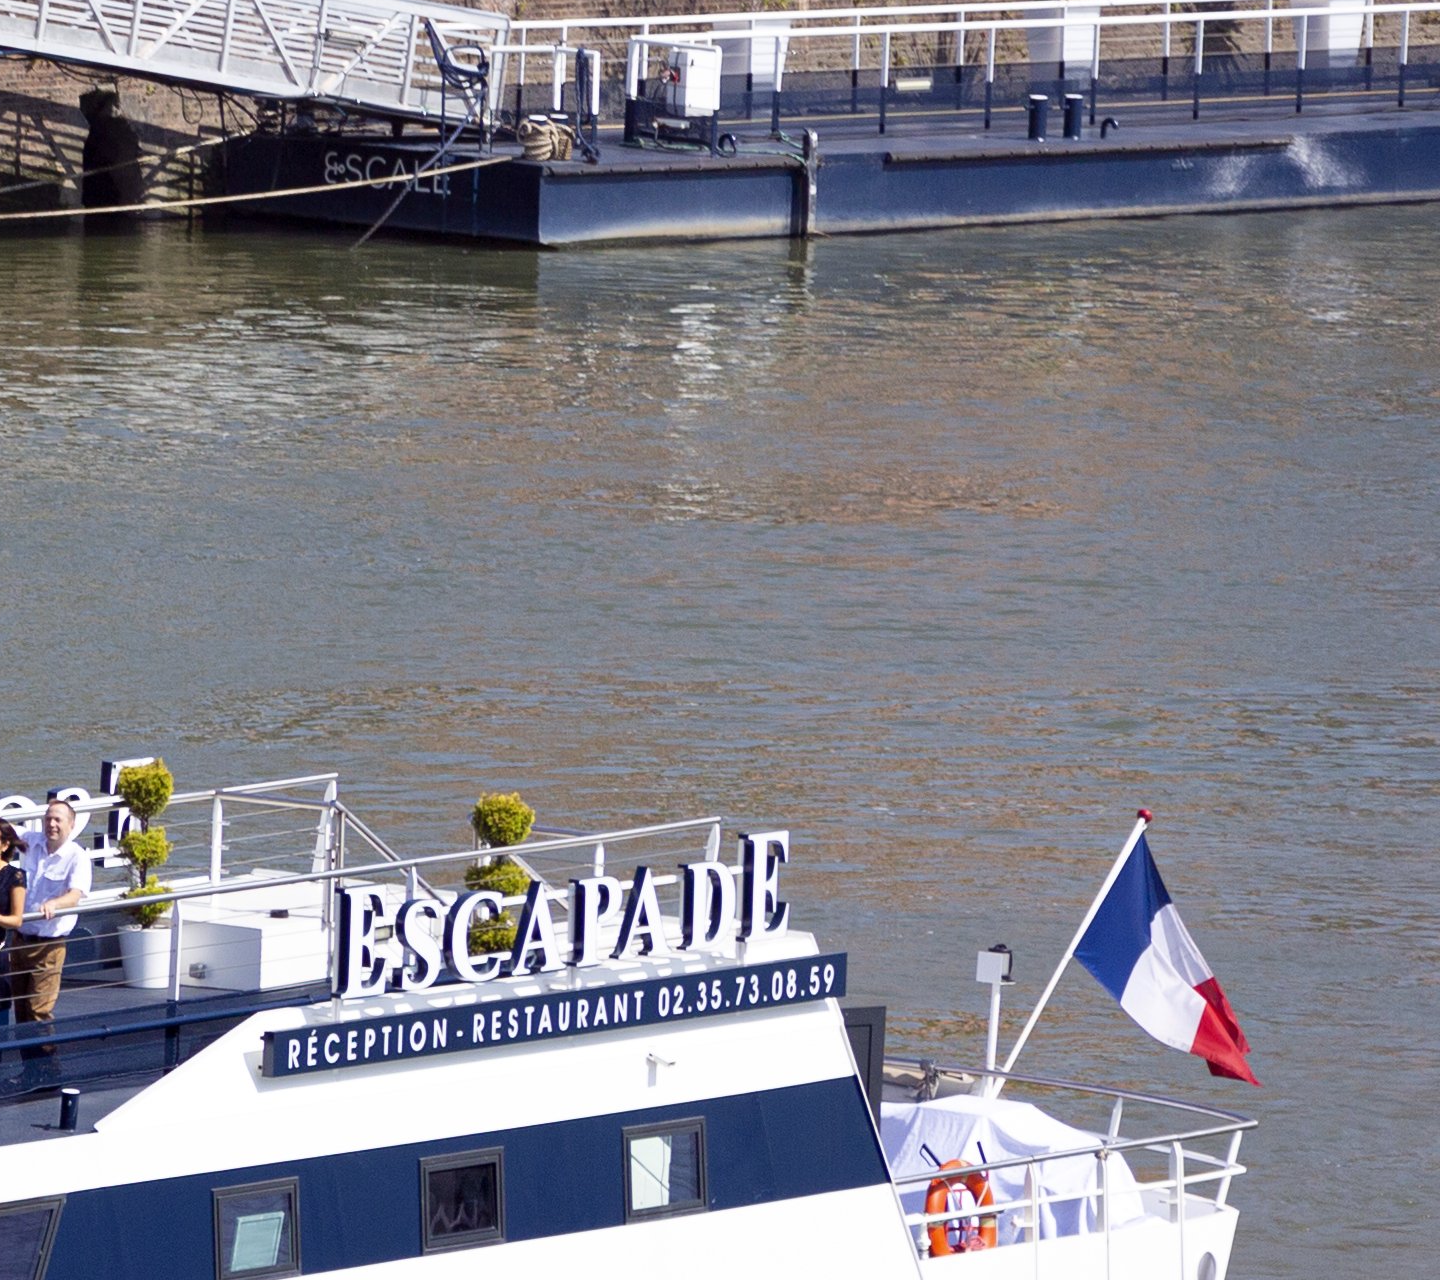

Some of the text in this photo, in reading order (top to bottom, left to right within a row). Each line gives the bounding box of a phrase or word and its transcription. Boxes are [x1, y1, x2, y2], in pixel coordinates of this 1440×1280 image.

[331, 830, 790, 1000] ESCAPADE
[286, 1015, 449, 1071] RÉCEPTION
[472, 989, 645, 1044] RESTAURANT
[657, 963, 836, 1018] 02.35.73.08.59
